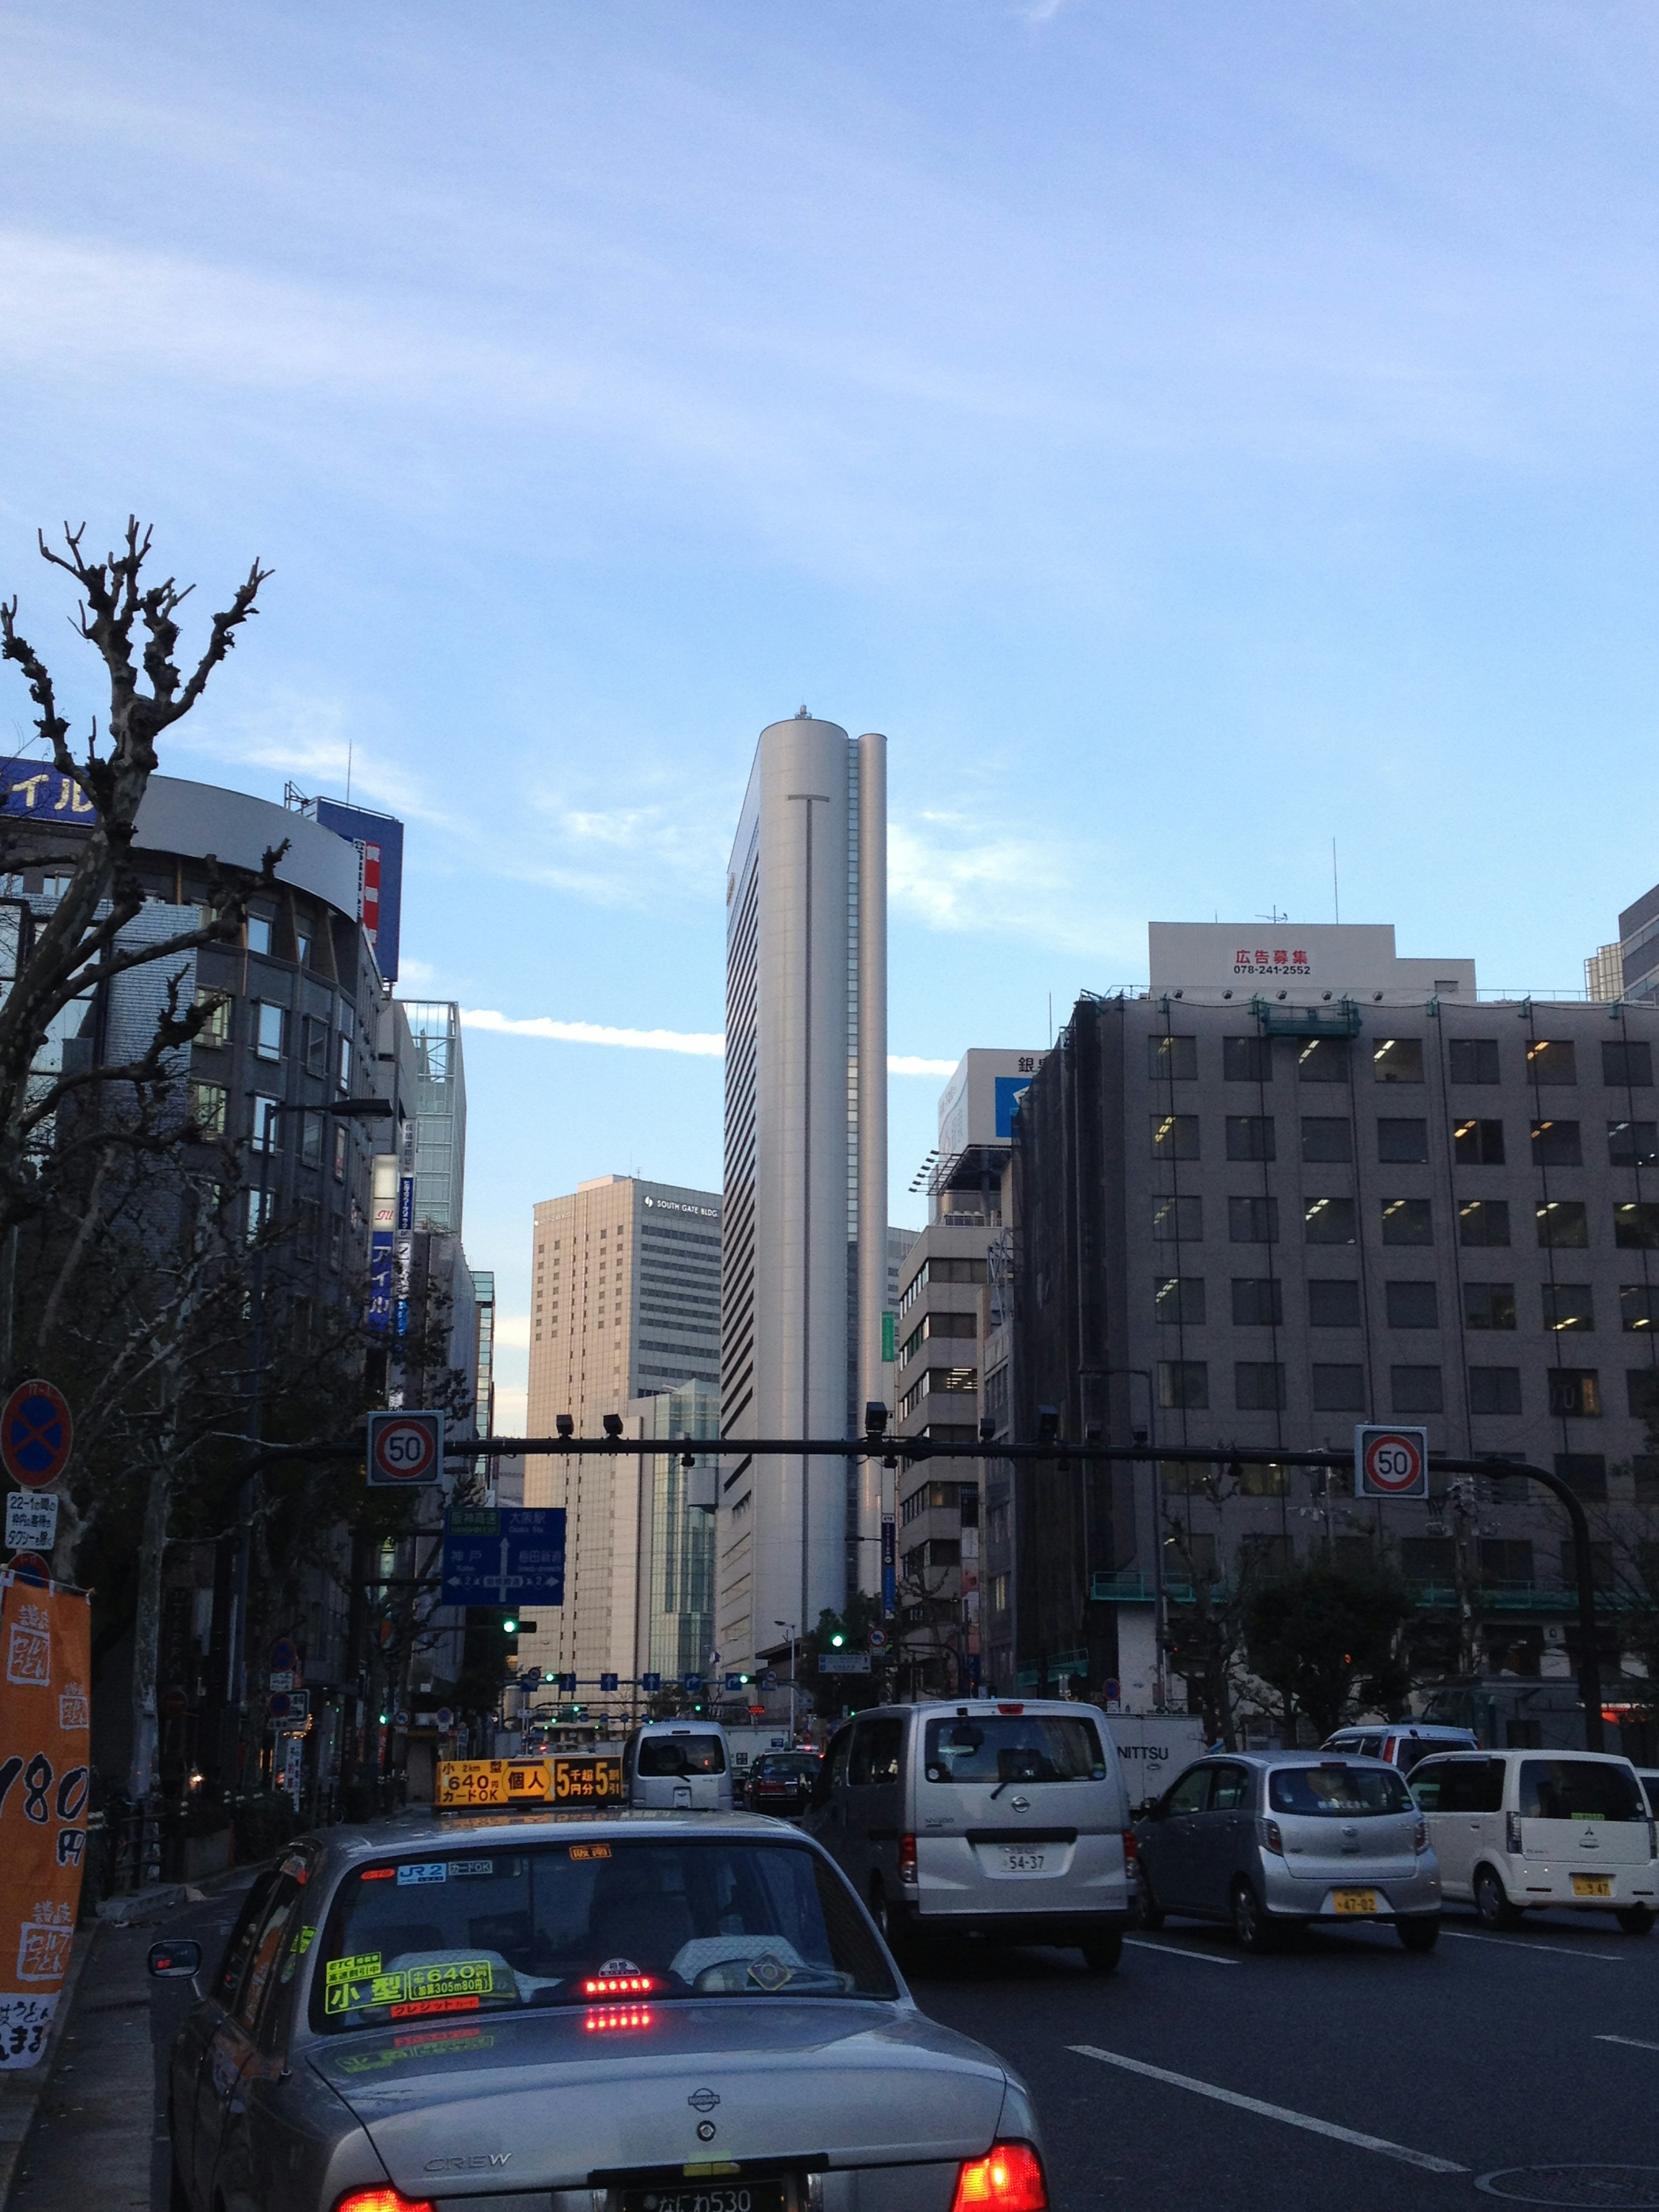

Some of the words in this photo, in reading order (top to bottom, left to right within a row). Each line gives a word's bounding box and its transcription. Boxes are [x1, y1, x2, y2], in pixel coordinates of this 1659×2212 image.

[0, 772, 94, 813] イル
[1236, 950, 1308, 964] 広告募集
[1233, 966, 1311, 975] 078-241-2552
[657, 1200, 679, 1211] SOUTH
[682, 1205, 699, 1214] GATE
[701, 1208, 719, 1217] BLDG.
[369, 1246, 391, 1314] アイル
[390, 1437, 420, 1462] 50
[1379, 1451, 1408, 1475] 50
[451, 1512, 497, 1525] 阪神高速
[509, 1511, 546, 1525] 大阪駅
[451, 1550, 482, 1563] 神戸
[519, 1550, 561, 1563] 梅田新道
[464, 1576, 471, 1585] 2
[536, 1576, 542, 1585] 2
[1117, 1746, 1168, 1760] NITTSU
[442, 1763, 455, 1775] 小
[489, 1762, 502, 1773] 型
[448, 1774, 499, 1790] 640円
[509, 1771, 544, 1790] 個人
[443, 1789, 498, 1802] カードOK
[56, 1827, 86, 1867] 円
[450, 1861, 490, 1874] カードOK
[1010, 1856, 1044, 1869] 54-37
[400, 1866, 425, 1877] JR
[430, 1865, 442, 1875] 2
[1344, 1898, 1375, 1910] 47-02
[26, 1952, 62, 1974] うどん
[330, 1959, 352, 1970] ETC
[329, 1965, 379, 1981] 高速割引中
[331, 1975, 402, 2009] 小型
[423, 2152, 512, 2172] CREW
[659, 2189, 751, 2212] なにわ530
